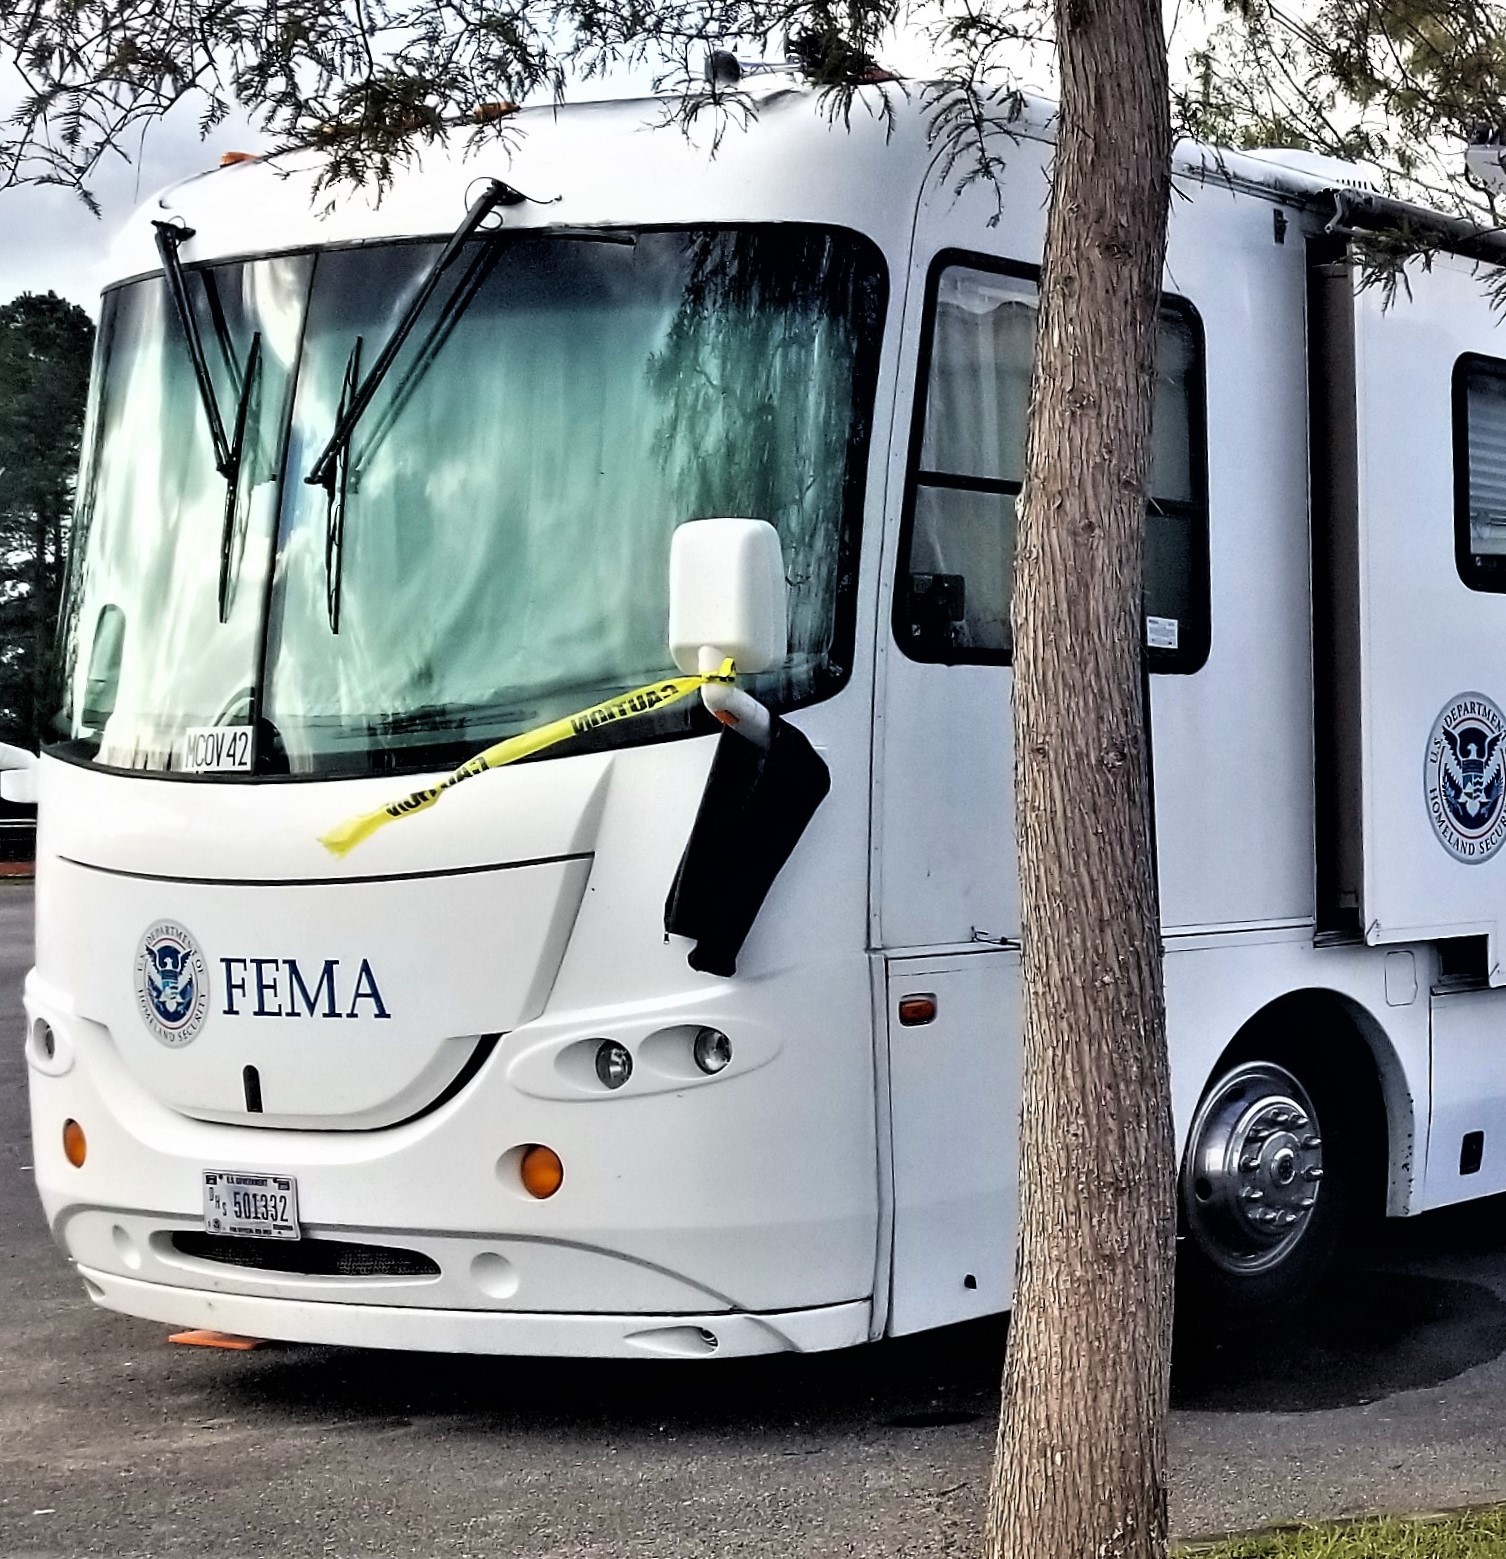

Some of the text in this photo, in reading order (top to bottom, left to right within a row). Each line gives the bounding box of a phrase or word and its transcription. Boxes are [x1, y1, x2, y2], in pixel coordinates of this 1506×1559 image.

[186, 732, 249, 767] MCOV 42
[1429, 787, 1476, 856] HOMELAND
[220, 957, 391, 1019] FEMA
[233, 1191, 289, 1222] 501332
